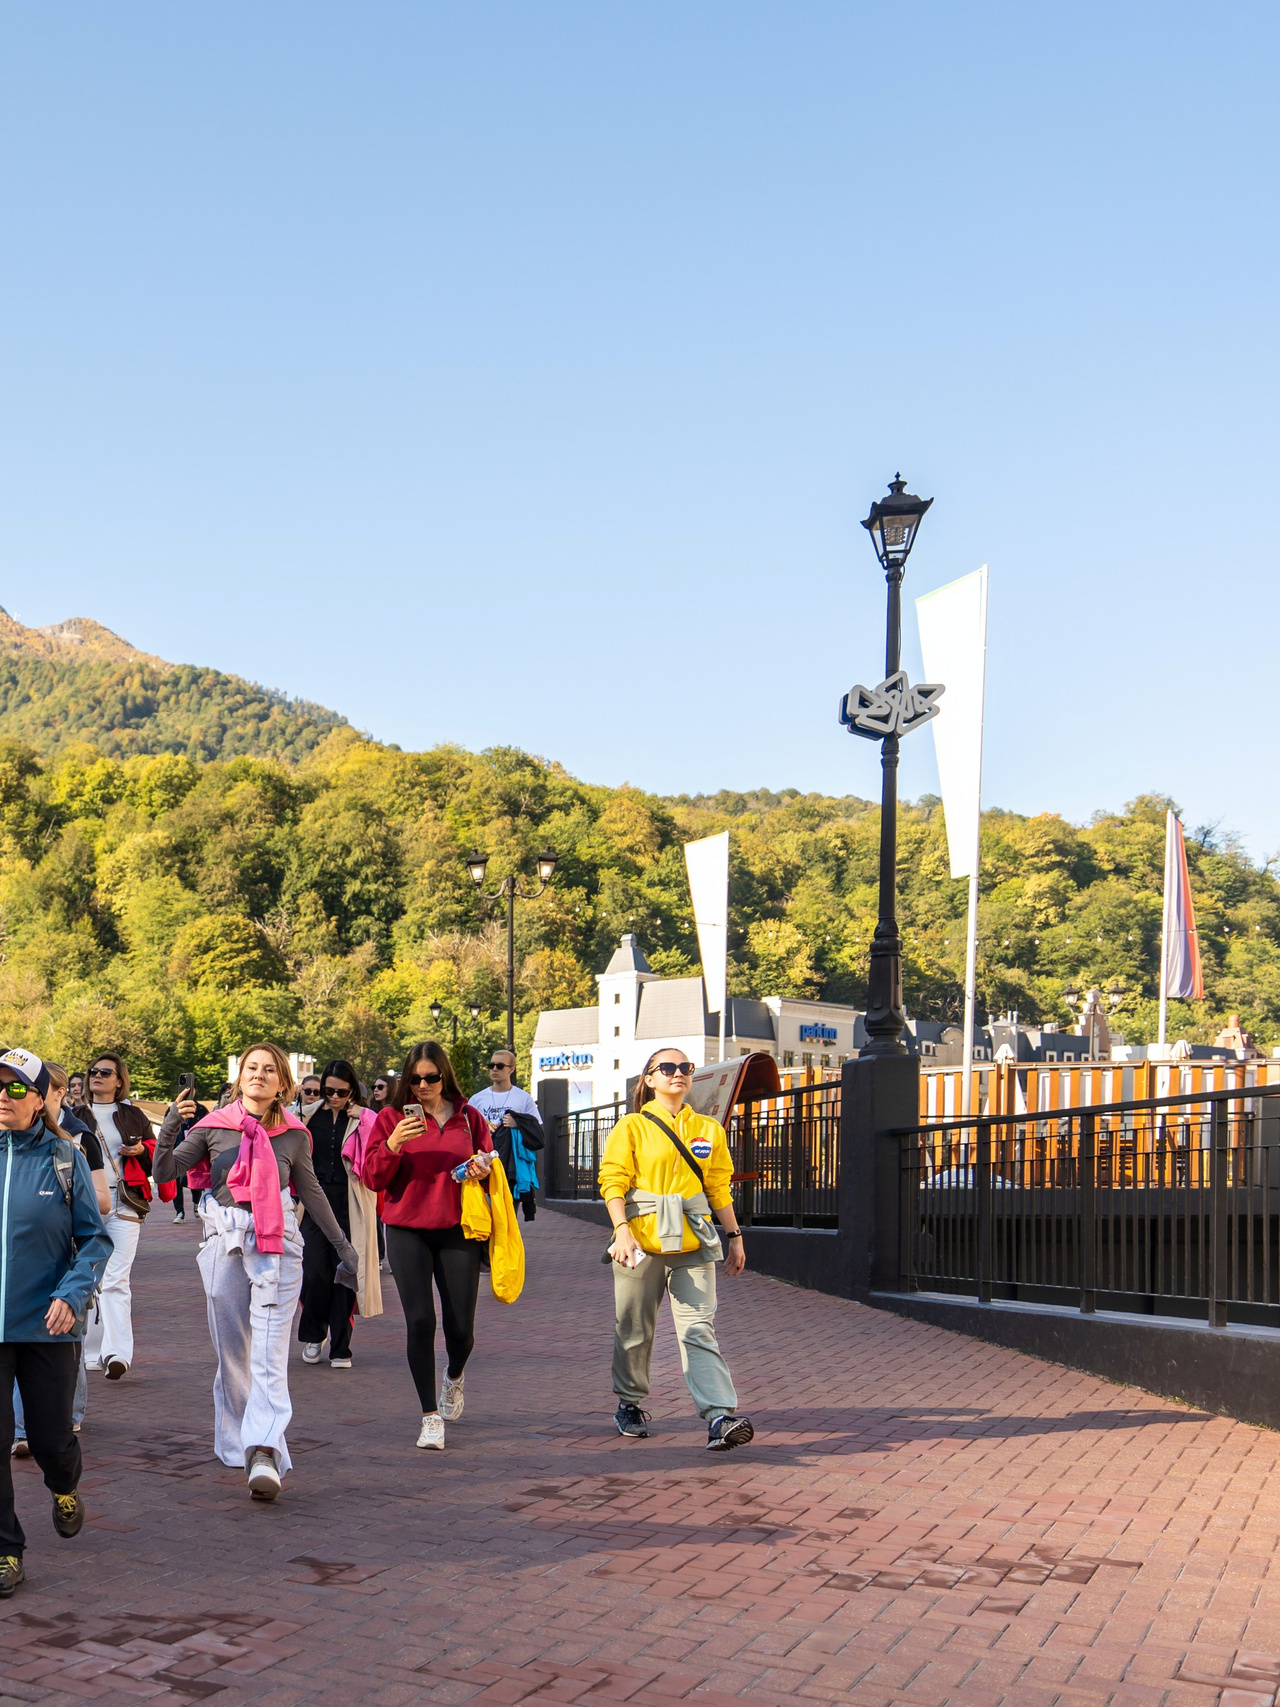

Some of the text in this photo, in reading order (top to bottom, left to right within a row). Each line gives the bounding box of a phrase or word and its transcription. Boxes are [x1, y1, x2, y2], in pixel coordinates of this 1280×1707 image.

[800, 1023, 837, 1041] park inn
[539, 1051, 593, 1070] park inn
